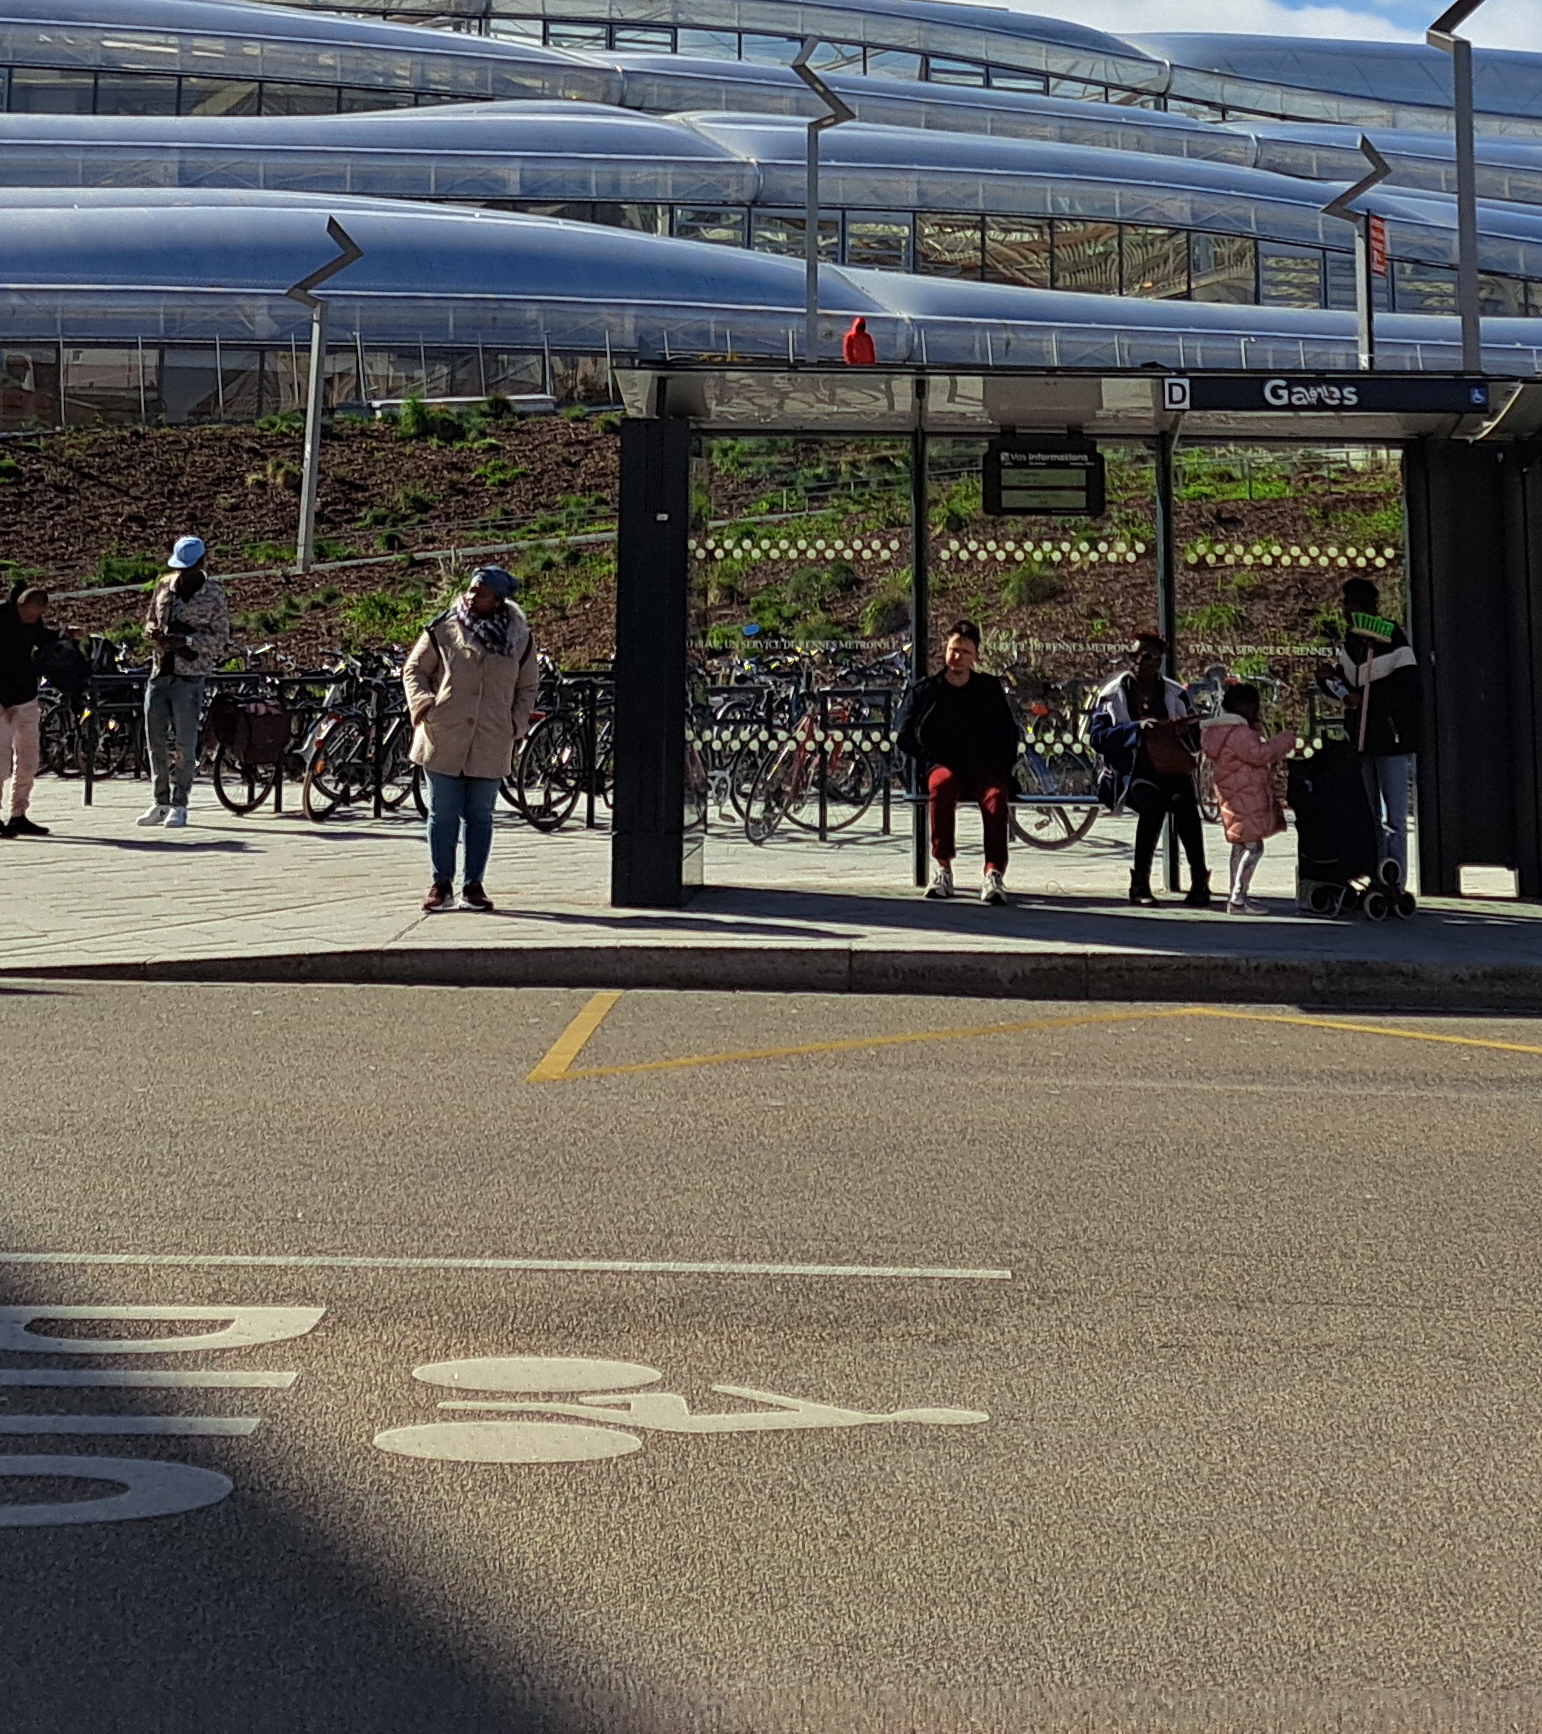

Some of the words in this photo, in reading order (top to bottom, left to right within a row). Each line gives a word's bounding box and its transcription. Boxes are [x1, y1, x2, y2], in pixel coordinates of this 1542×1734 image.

[1167, 381, 1188, 406] D
[1236, 645, 1276, 656] SERVICE
[1276, 646, 1293, 656] DE
[1293, 646, 1334, 657] RENNES
